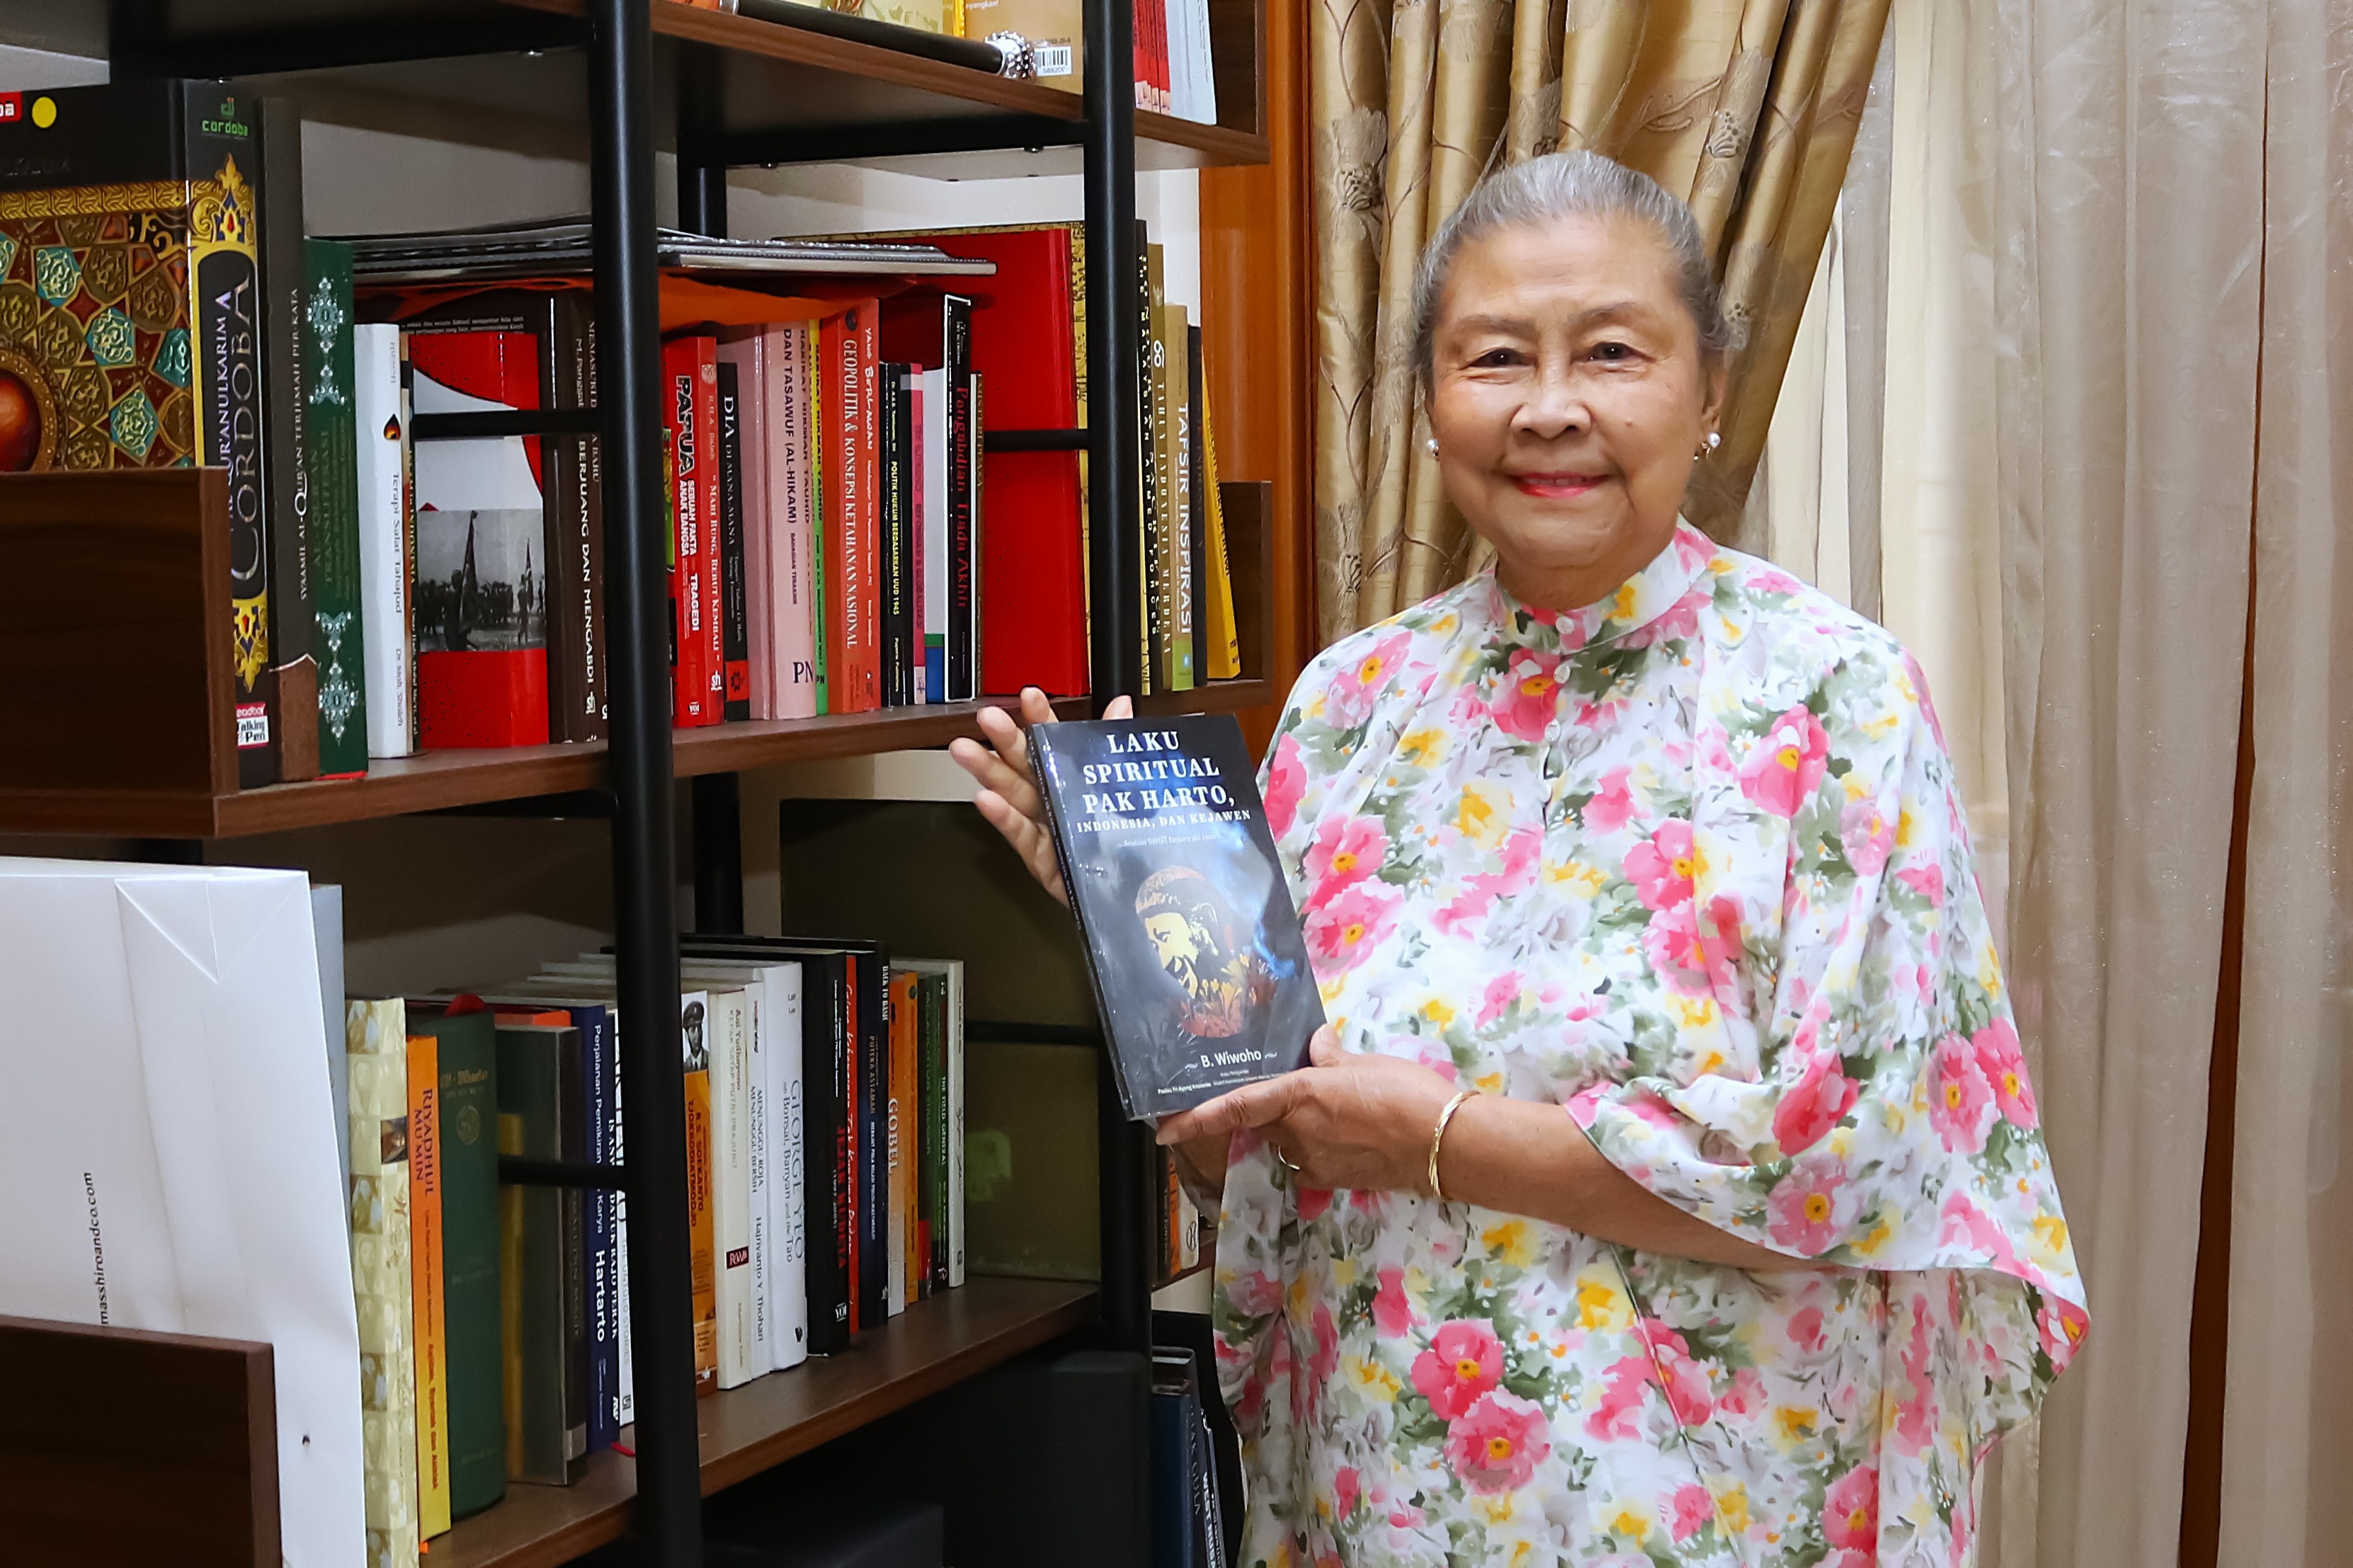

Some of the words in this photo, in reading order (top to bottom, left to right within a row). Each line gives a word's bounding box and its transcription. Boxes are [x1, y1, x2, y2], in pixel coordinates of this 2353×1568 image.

[202, 120, 249, 137] cordoba
[783, 328, 792, 361] DAN
[292, 363, 302, 442] TERJEMAH
[784, 366, 794, 437] TASAWUF
[843, 339, 858, 420] GEOPOLITIK
[1141, 311, 1150, 440] MALAYSIAN
[232, 275, 261, 583] CORDOBA
[676, 375, 695, 477] PAPUA
[724, 395, 734, 440] DIA
[845, 422, 858, 433] &
[953, 387, 969, 493] Pengabdian
[726, 444, 732, 459] DI
[845, 437, 856, 500] KONSEPSI
[1178, 402, 1190, 495] TAFSIR
[392, 473, 400, 515] Terapi
[579, 440, 589, 537] BERJUANG
[680, 480, 688, 511] ANAK
[687, 479, 695, 521] SEBUAH
[785, 442, 797, 524] (AL-HIKAM)
[1145, 459, 1153, 532] ARMED
[1159, 453, 1168, 556] INDONESIA
[680, 513, 690, 558] BANGSA
[688, 523, 697, 556] FAKTA
[845, 503, 857, 581] KETAHANAN
[957, 503, 969, 552] Tiada
[299, 545, 308, 600] SYAAMIL
[394, 561, 403, 614] Tahajud
[581, 544, 591, 582] DAN
[957, 558, 969, 609] Akhir
[1149, 549, 1157, 635] FORCES
[690, 572, 700, 631] TRAGEDI
[846, 584, 858, 649] NASIONAL
[1162, 568, 1170, 655] MERDEKA
[583, 588, 594, 683] MENGABDI
[793, 660, 814, 685] PN
[1083, 757, 1220, 785] SPIRITUAL
[1107, 731, 1180, 754] LAKU
[1077, 818, 1156, 834] INDONESIA,
[1159, 816, 1186, 827] DAN
[1190, 809, 1251, 824] KEJAWEN
[1083, 791, 1136, 814] PAK
[1140, 785, 1236, 810] HARTO,
[882, 988, 889, 999] TO
[593, 1024, 603, 1095] Perjalanan
[1201, 1055, 1214, 1068] B.
[1214, 1048, 1263, 1067] Wiwoho
[422, 1088, 433, 1198] RIYADHUL
[595, 1099, 603, 1164] Pemikiran
[790, 1080, 803, 1196] GEORGE
[887, 1098, 899, 1174] GOBEL
[783, 1149, 792, 1200] Banyan
[83, 1171, 110, 1326] masshiroandco.com
[793, 1202, 804, 1259] YEO
[596, 1249, 606, 1342] Hartarto
